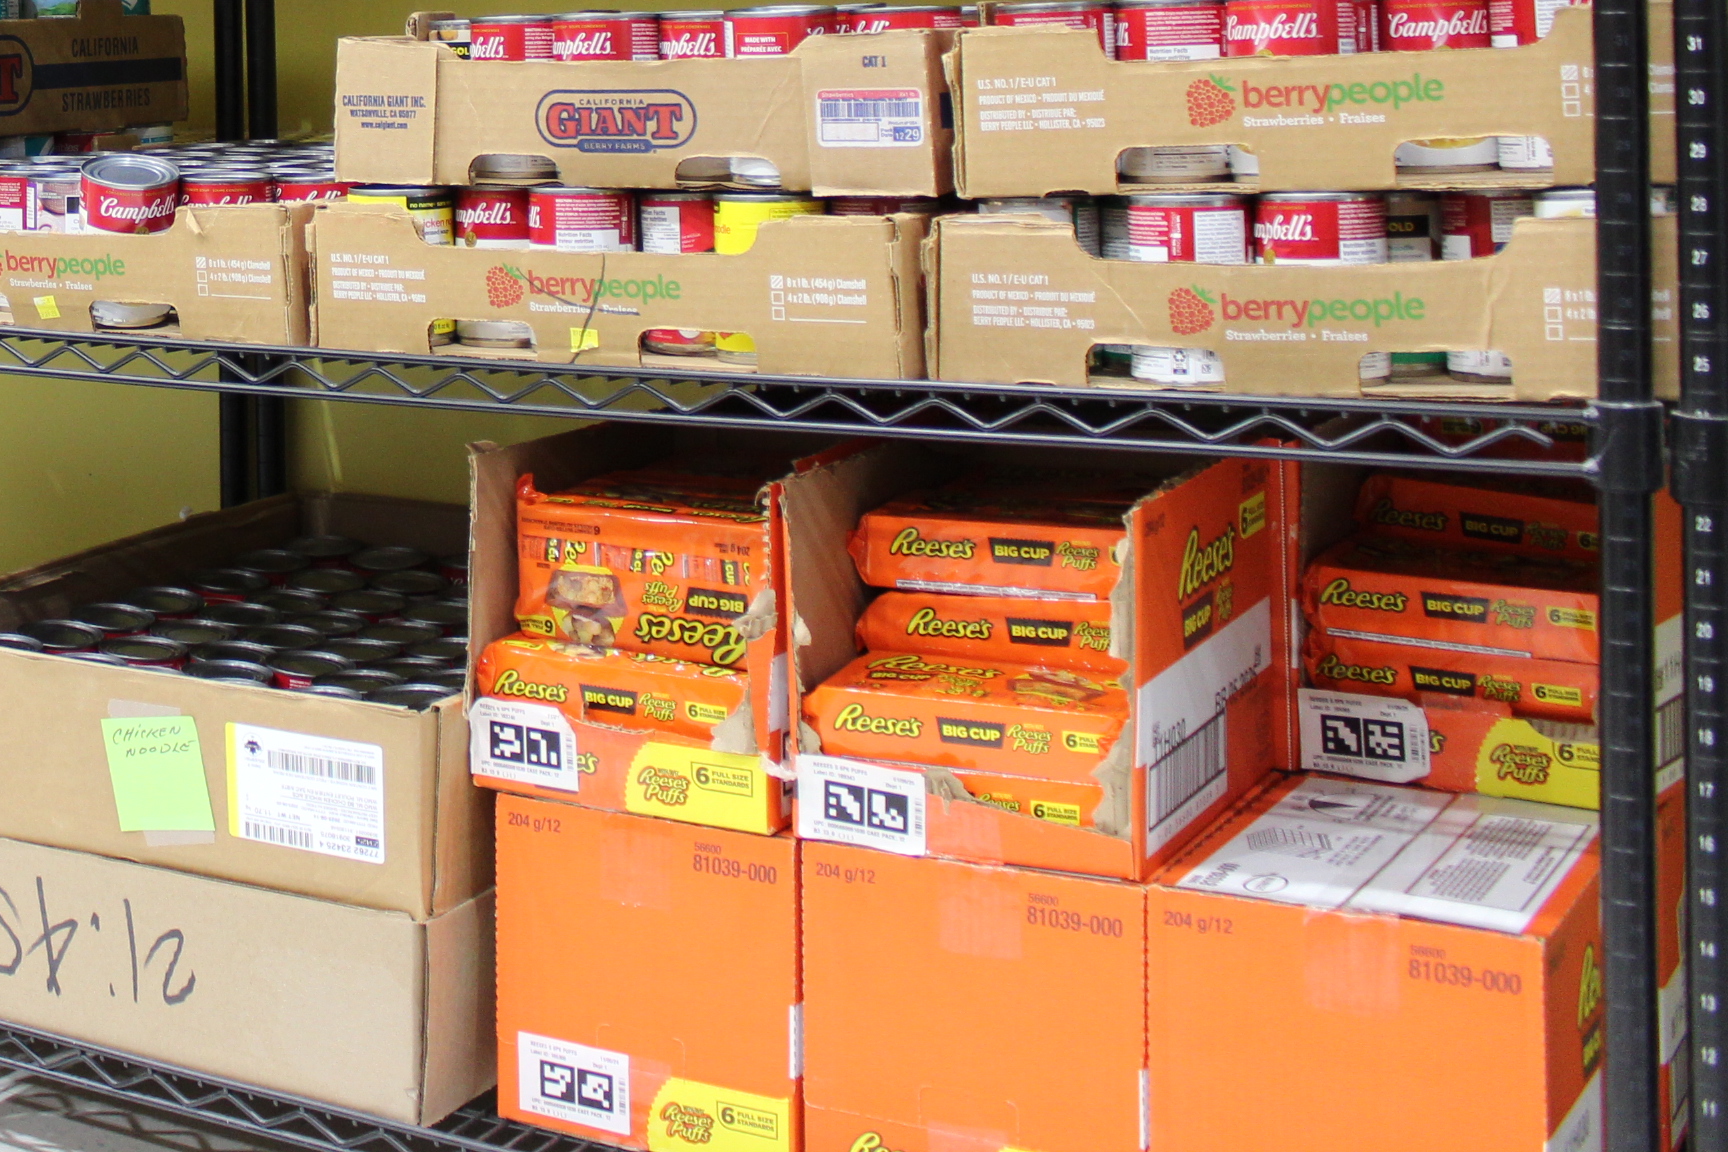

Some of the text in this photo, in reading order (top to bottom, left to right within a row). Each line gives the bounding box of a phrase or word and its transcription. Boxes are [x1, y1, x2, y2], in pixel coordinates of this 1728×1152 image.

[1226, 10, 1319, 42] Campbell's
[1387, 8, 1488, 41] Campbell's
[72, 36, 139, 57] CALIFORNIA
[862, 55, 880, 68] CAT
[62, 88, 150, 112] STRAWBERRIES
[342, 95, 426, 108] CALIFORNIA GIANT INC.
[1243, 73, 1444, 114] berrypeople
[546, 102, 683, 140] GIANT
[1243, 111, 1385, 128] Strawberries Fraises
[905, 128, 920, 140] 29
[100, 195, 175, 225] Campbell's
[5, 248, 125, 279] berrypeople
[528, 268, 681, 304] berrypeople
[1222, 292, 1426, 328] berrypeople
[1226, 330, 1368, 342] Strawberries Fraises
[890, 527, 976, 559] Reese's
[994, 544, 1050, 560] BIG CUP
[1322, 579, 1407, 611] Reese's
[1426, 599, 1484, 615] BIG CUP
[908, 608, 993, 640] Reese's
[1012, 625, 1068, 640] BIG CUP
[1320, 654, 1397, 685] Reese's
[493, 669, 569, 703] Reese's
[1415, 673, 1471, 690] BIG CUP
[584, 691, 634, 708] BIG CUP
[644, 706, 675, 722] Puffs
[834, 703, 924, 738] Reese's
[942, 725, 1001, 742] BIG CUP
[125, 739, 197, 758] NOODLE
[1013, 738, 1050, 755] Puffs
[1558, 742, 1574, 761] 6
[696, 766, 710, 785] 6
[712, 771, 749, 782] FULL SIZE
[712, 779, 749, 790] STANDARDS
[1499, 762, 1549, 785] Puffs
[646, 785, 687, 804] Puffs
[508, 812, 562, 835] 204 g/12
[692, 854, 778, 886] 81039-000
[815, 862, 876, 886] 204 g/12
[1026, 905, 1124, 939] 81039-000
[1164, 911, 1233, 937] 204 g/12
[1408, 958, 1523, 995] 81039-000
[721, 1105, 735, 1124] 6
[669, 1123, 711, 1146] Puffs
